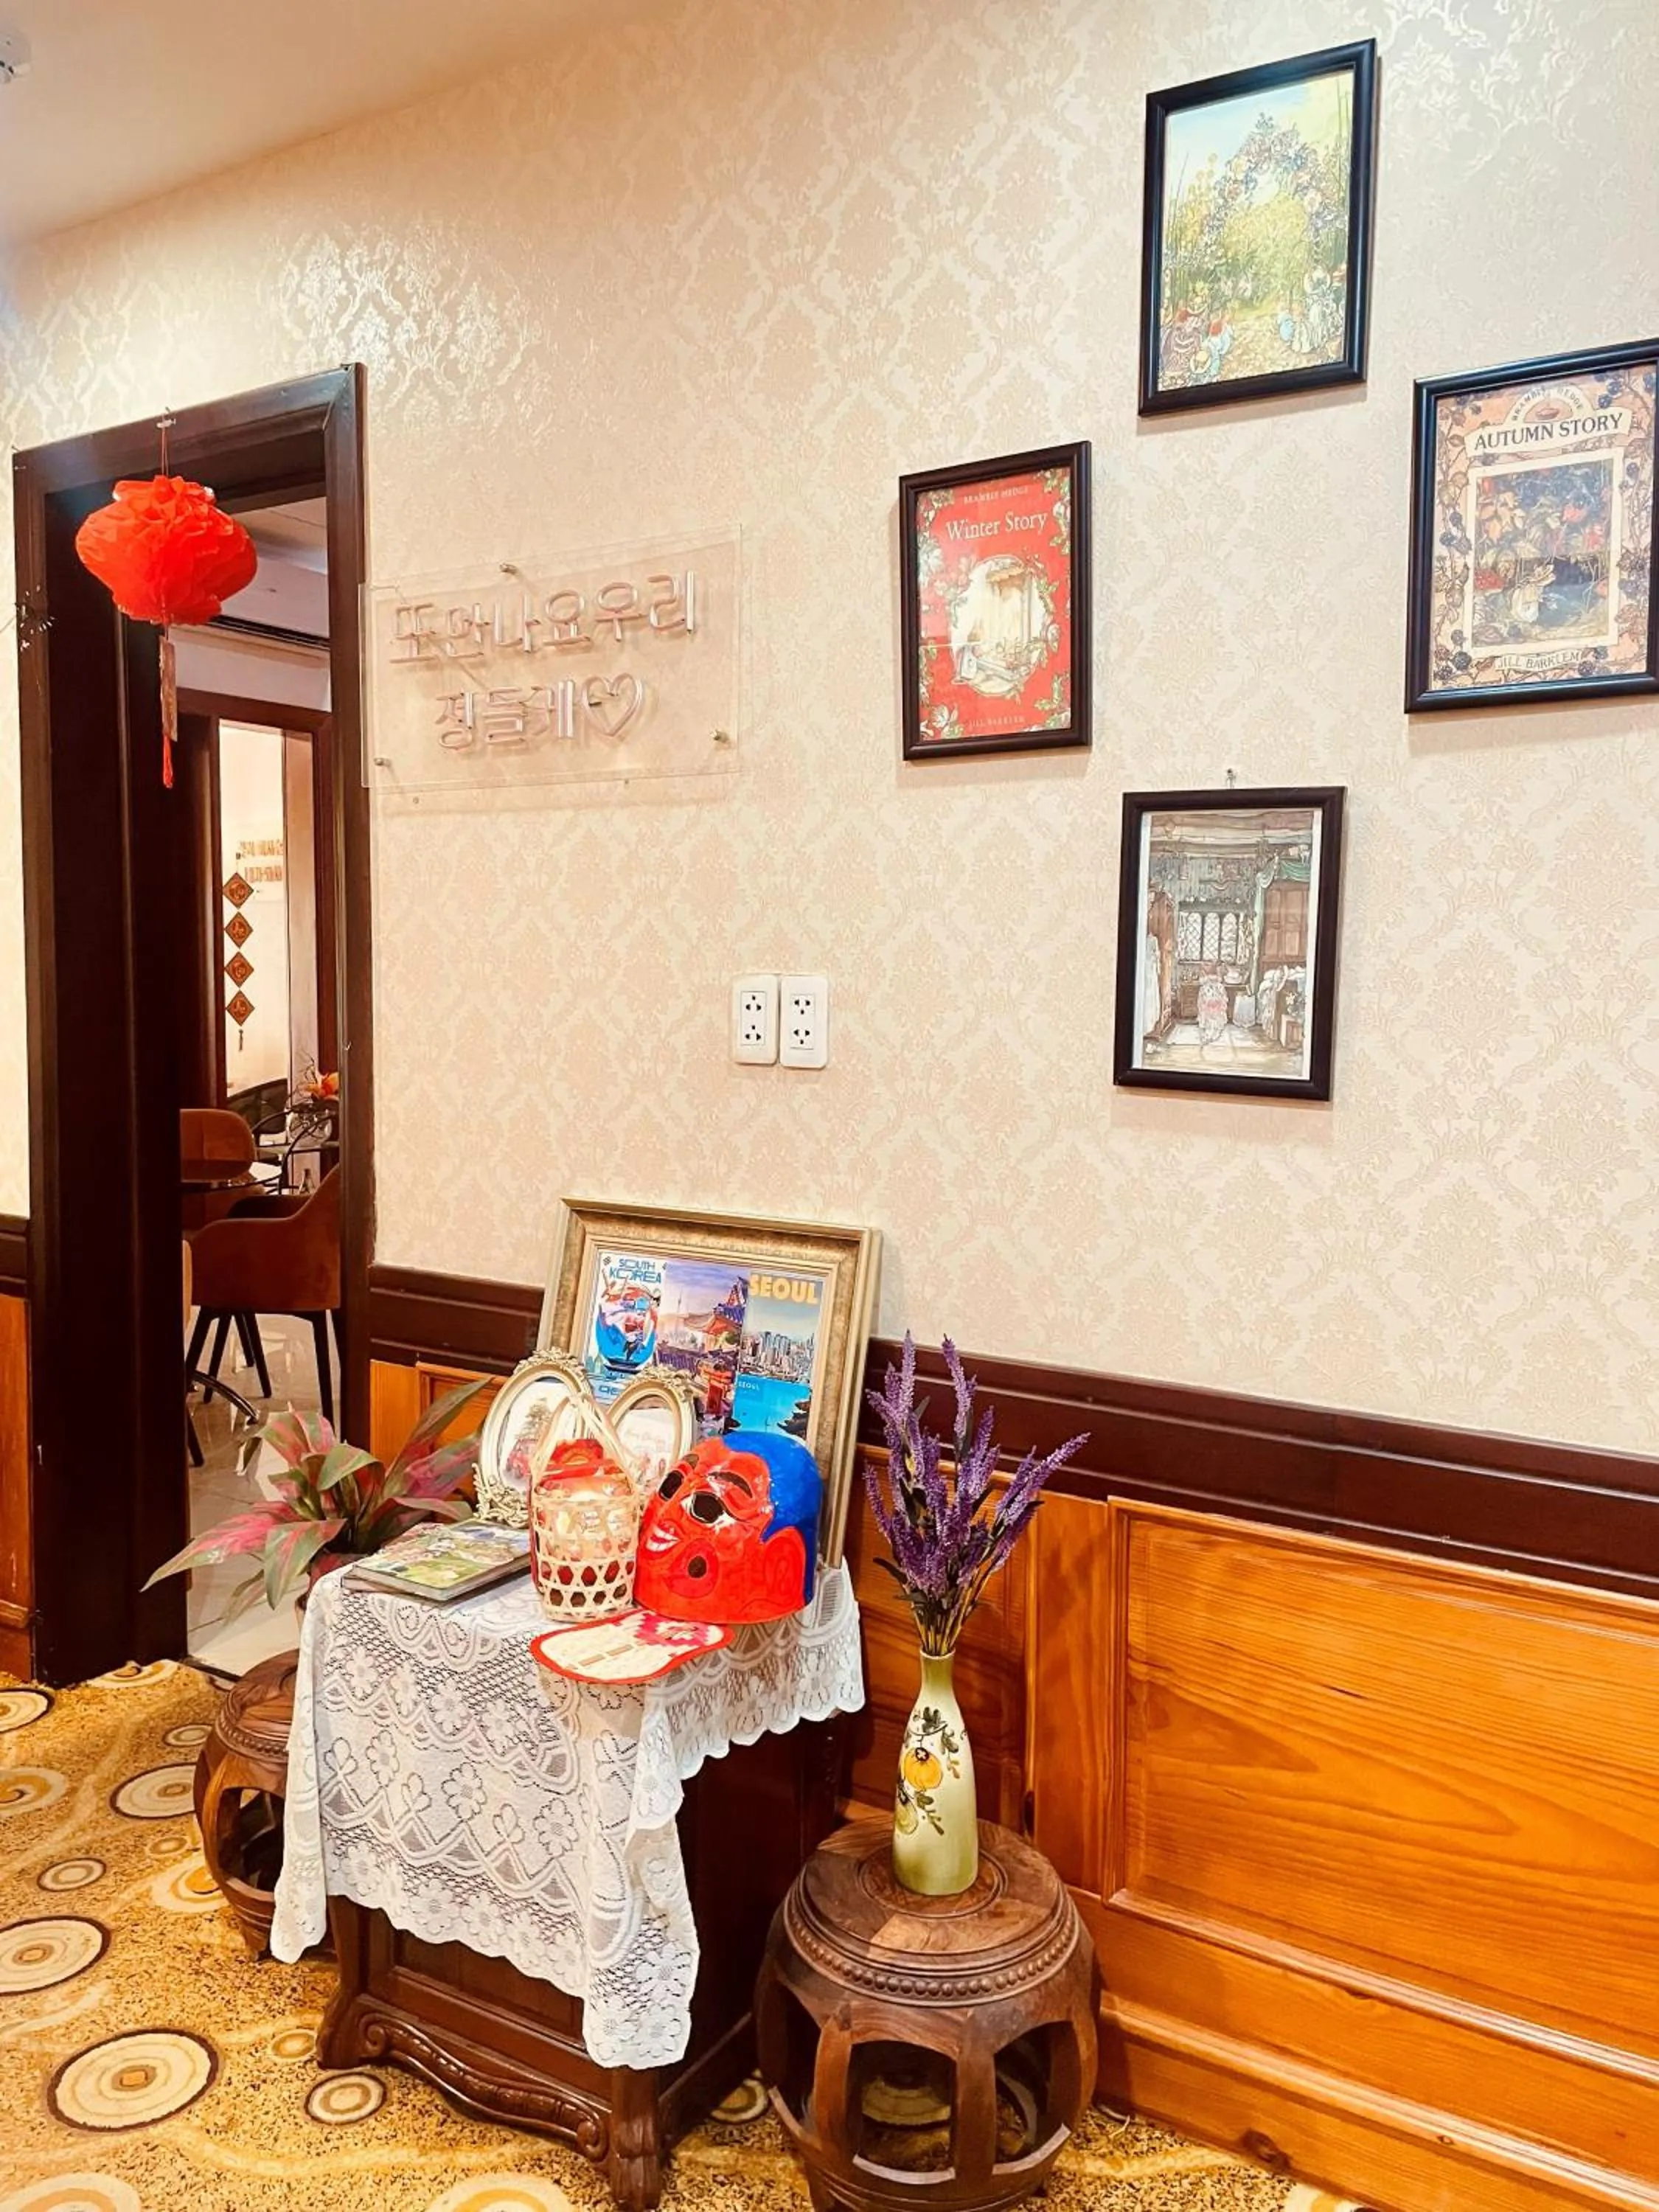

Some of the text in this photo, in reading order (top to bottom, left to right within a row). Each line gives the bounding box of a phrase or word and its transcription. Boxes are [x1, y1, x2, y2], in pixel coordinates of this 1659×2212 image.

[1474, 412, 1623, 451] AUTUMN STORY
[945, 510, 1048, 542] Winter Story
[1498, 649, 1582, 669] JILL BARKLEM
[609, 1267, 662, 1284] KOREA
[619, 1258, 655, 1270] SOUTH
[748, 1273, 818, 1305] SEOUL
